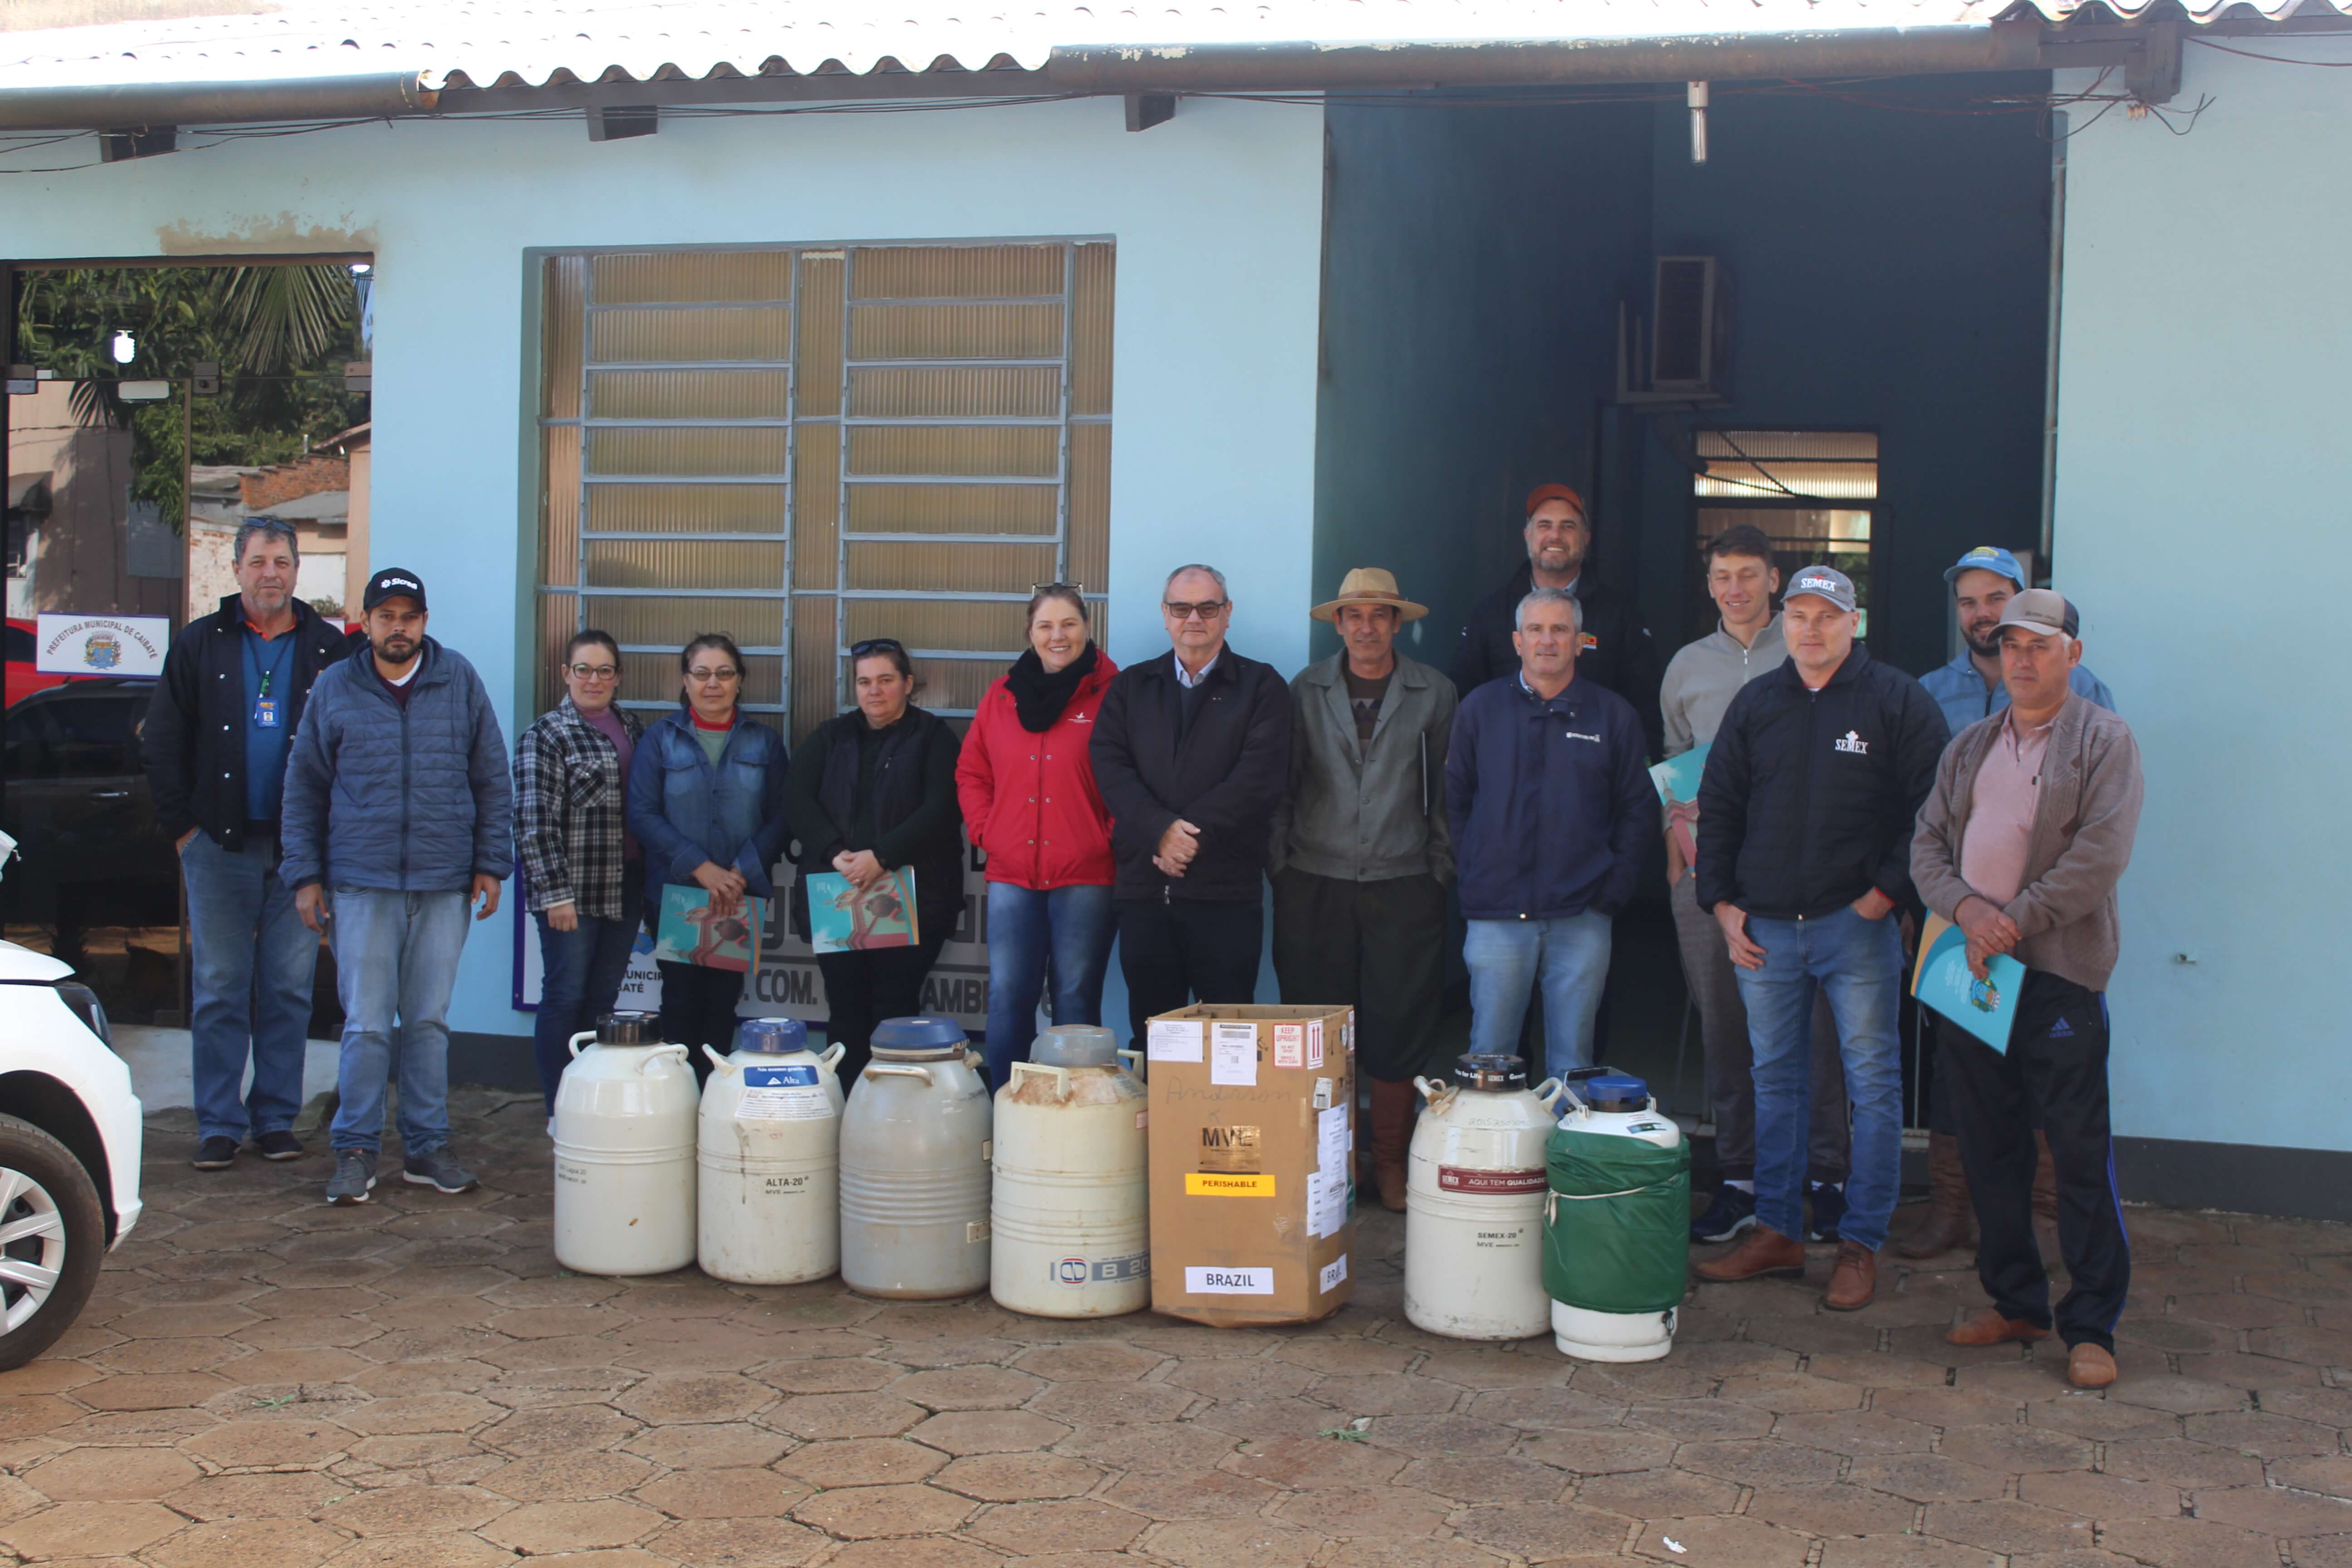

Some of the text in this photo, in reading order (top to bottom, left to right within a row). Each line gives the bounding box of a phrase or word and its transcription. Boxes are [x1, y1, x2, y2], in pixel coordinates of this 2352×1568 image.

[1800, 577, 1836, 592] SEMEX
[47, 620, 158, 659] PREFEITURA MUNICIPAL DE CAIBATÉ
[1835, 739, 1869, 754] SEMEX
[783, 1076, 799, 1084] Alta
[1203, 1127, 1252, 1147] MVE
[766, 1177, 803, 1186] ALTA-20
[1206, 1273, 1254, 1286] BRAZIL
